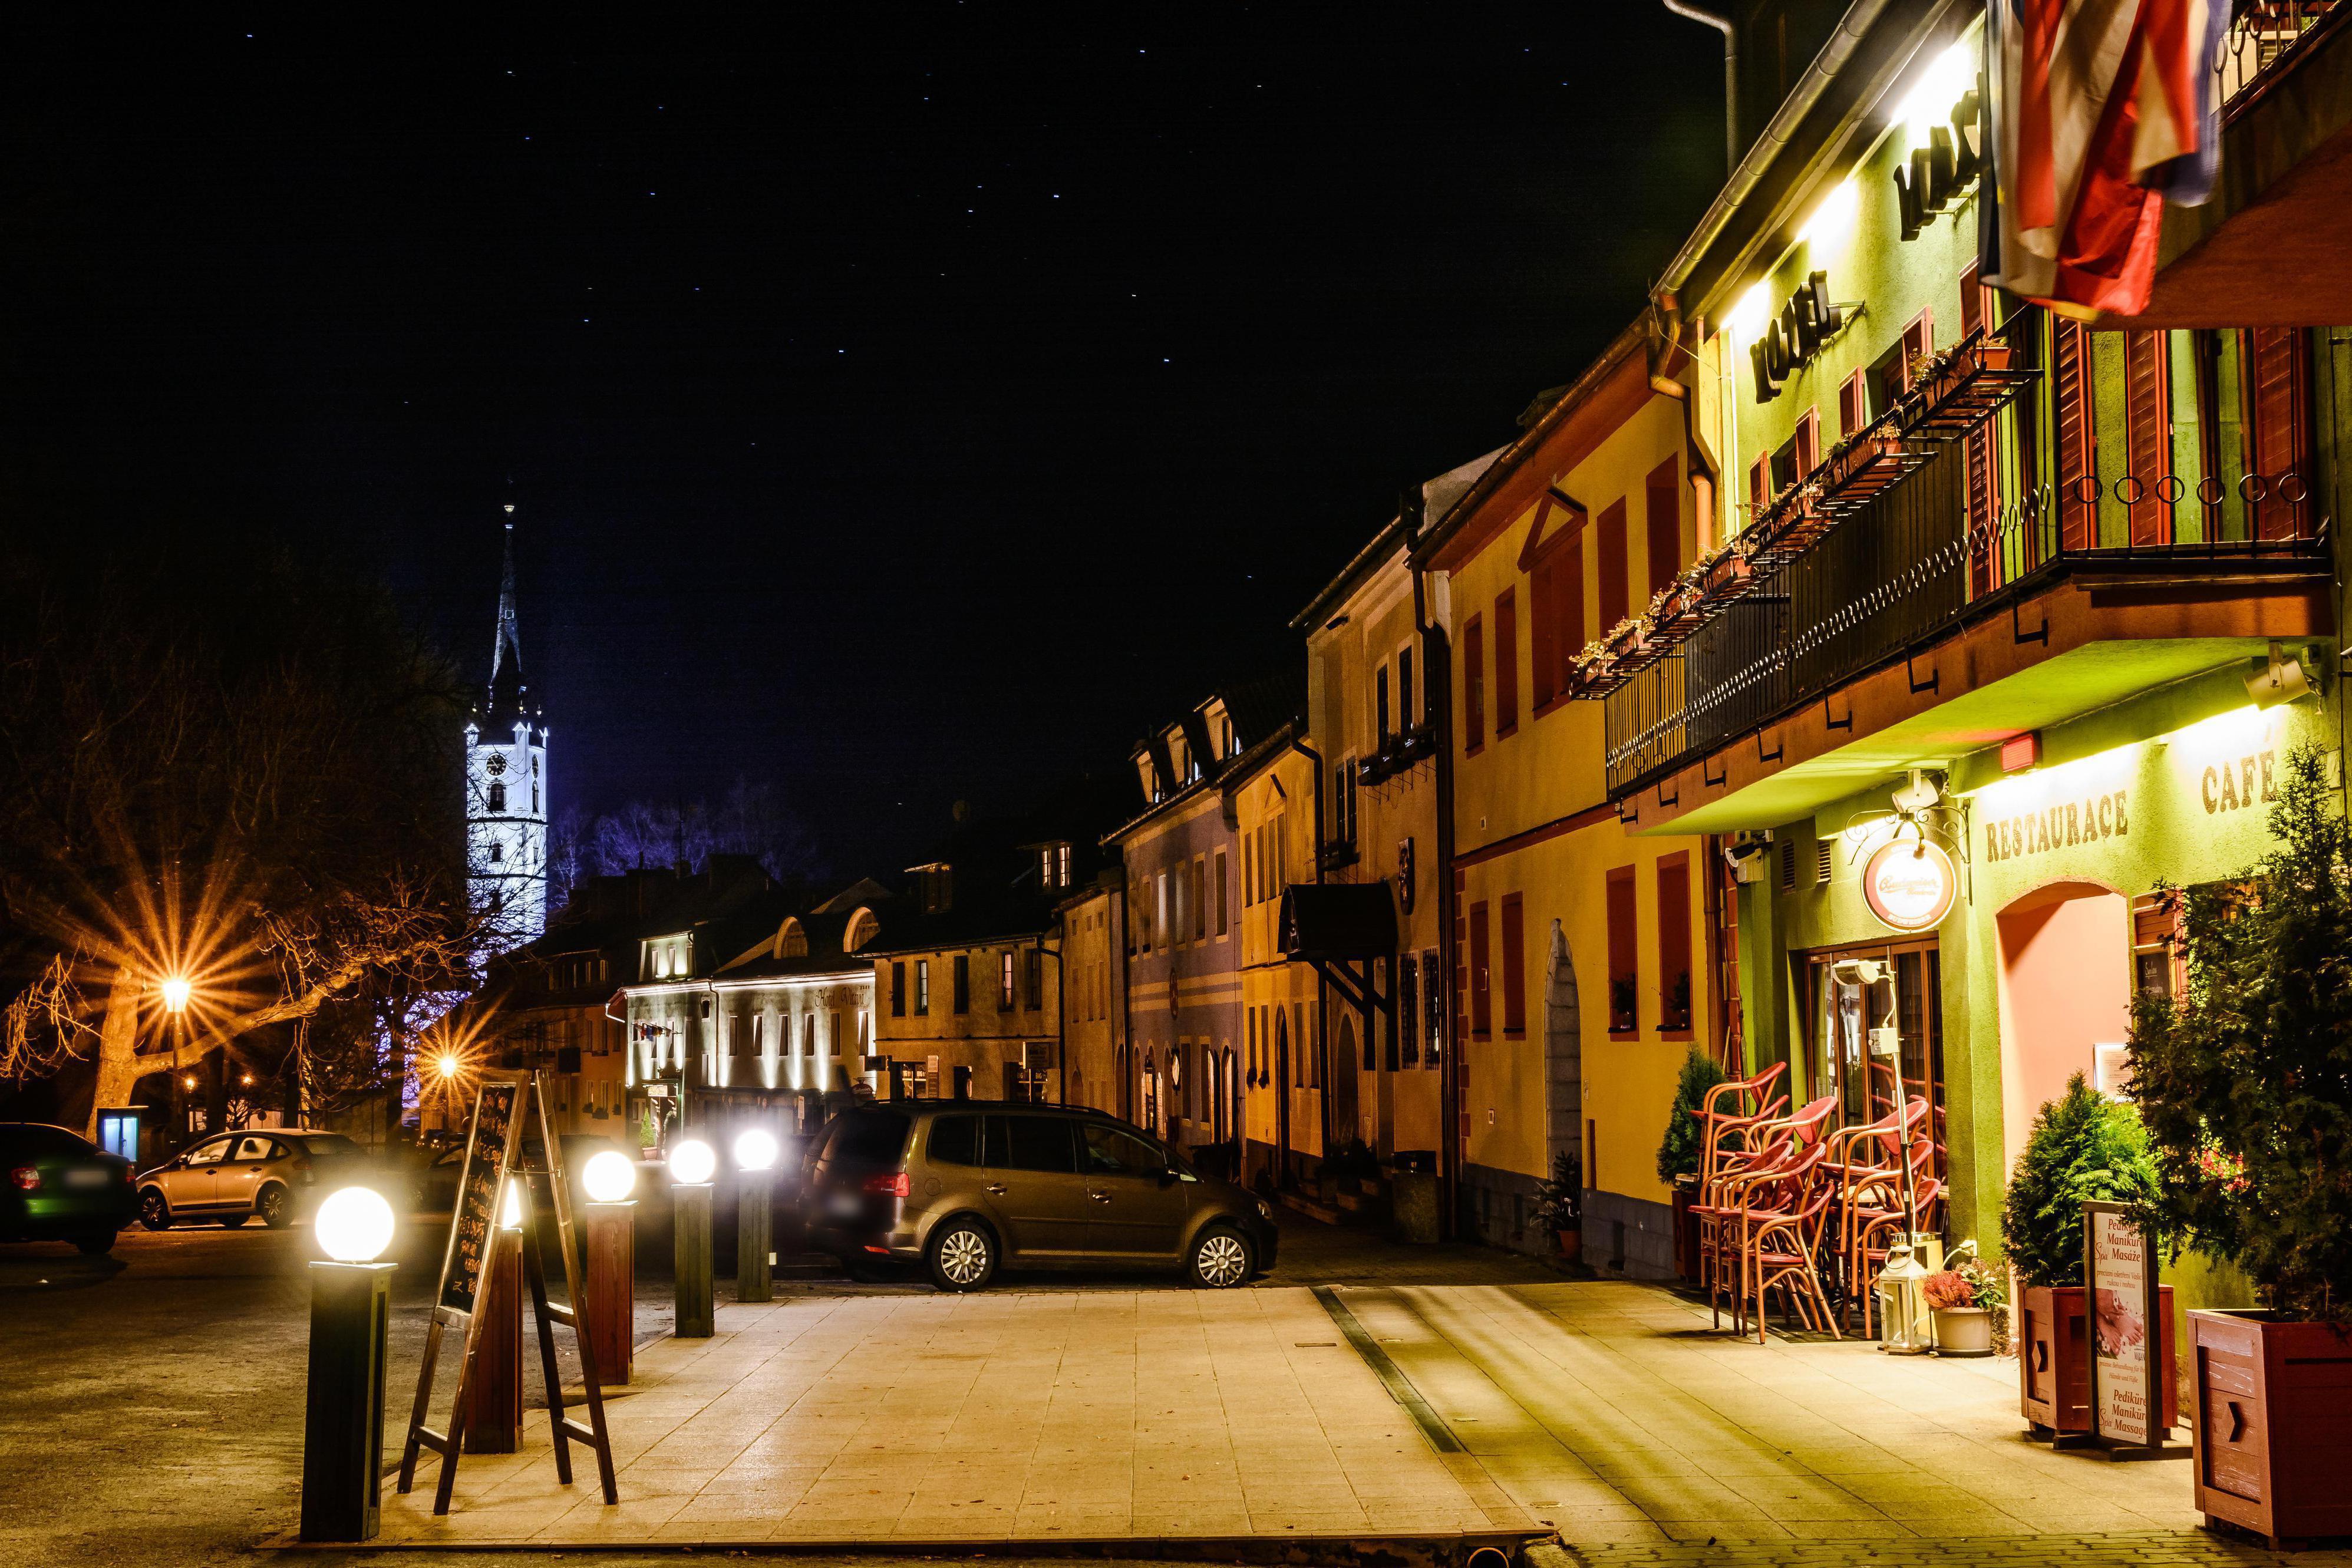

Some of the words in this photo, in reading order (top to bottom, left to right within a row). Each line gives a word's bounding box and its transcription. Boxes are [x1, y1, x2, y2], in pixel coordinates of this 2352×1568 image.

[1750, 270, 1842, 404] HOTEL
[1986, 790, 2127, 863] RESTAURACE
[814, 986, 834, 1007] Hotel
[2112, 1247, 2141, 1262] Masáže
[2113, 1389, 2147, 1407] Pediküre
[2112, 1404, 2147, 1421] Manikür
[2114, 1418, 2147, 1439] Massage
